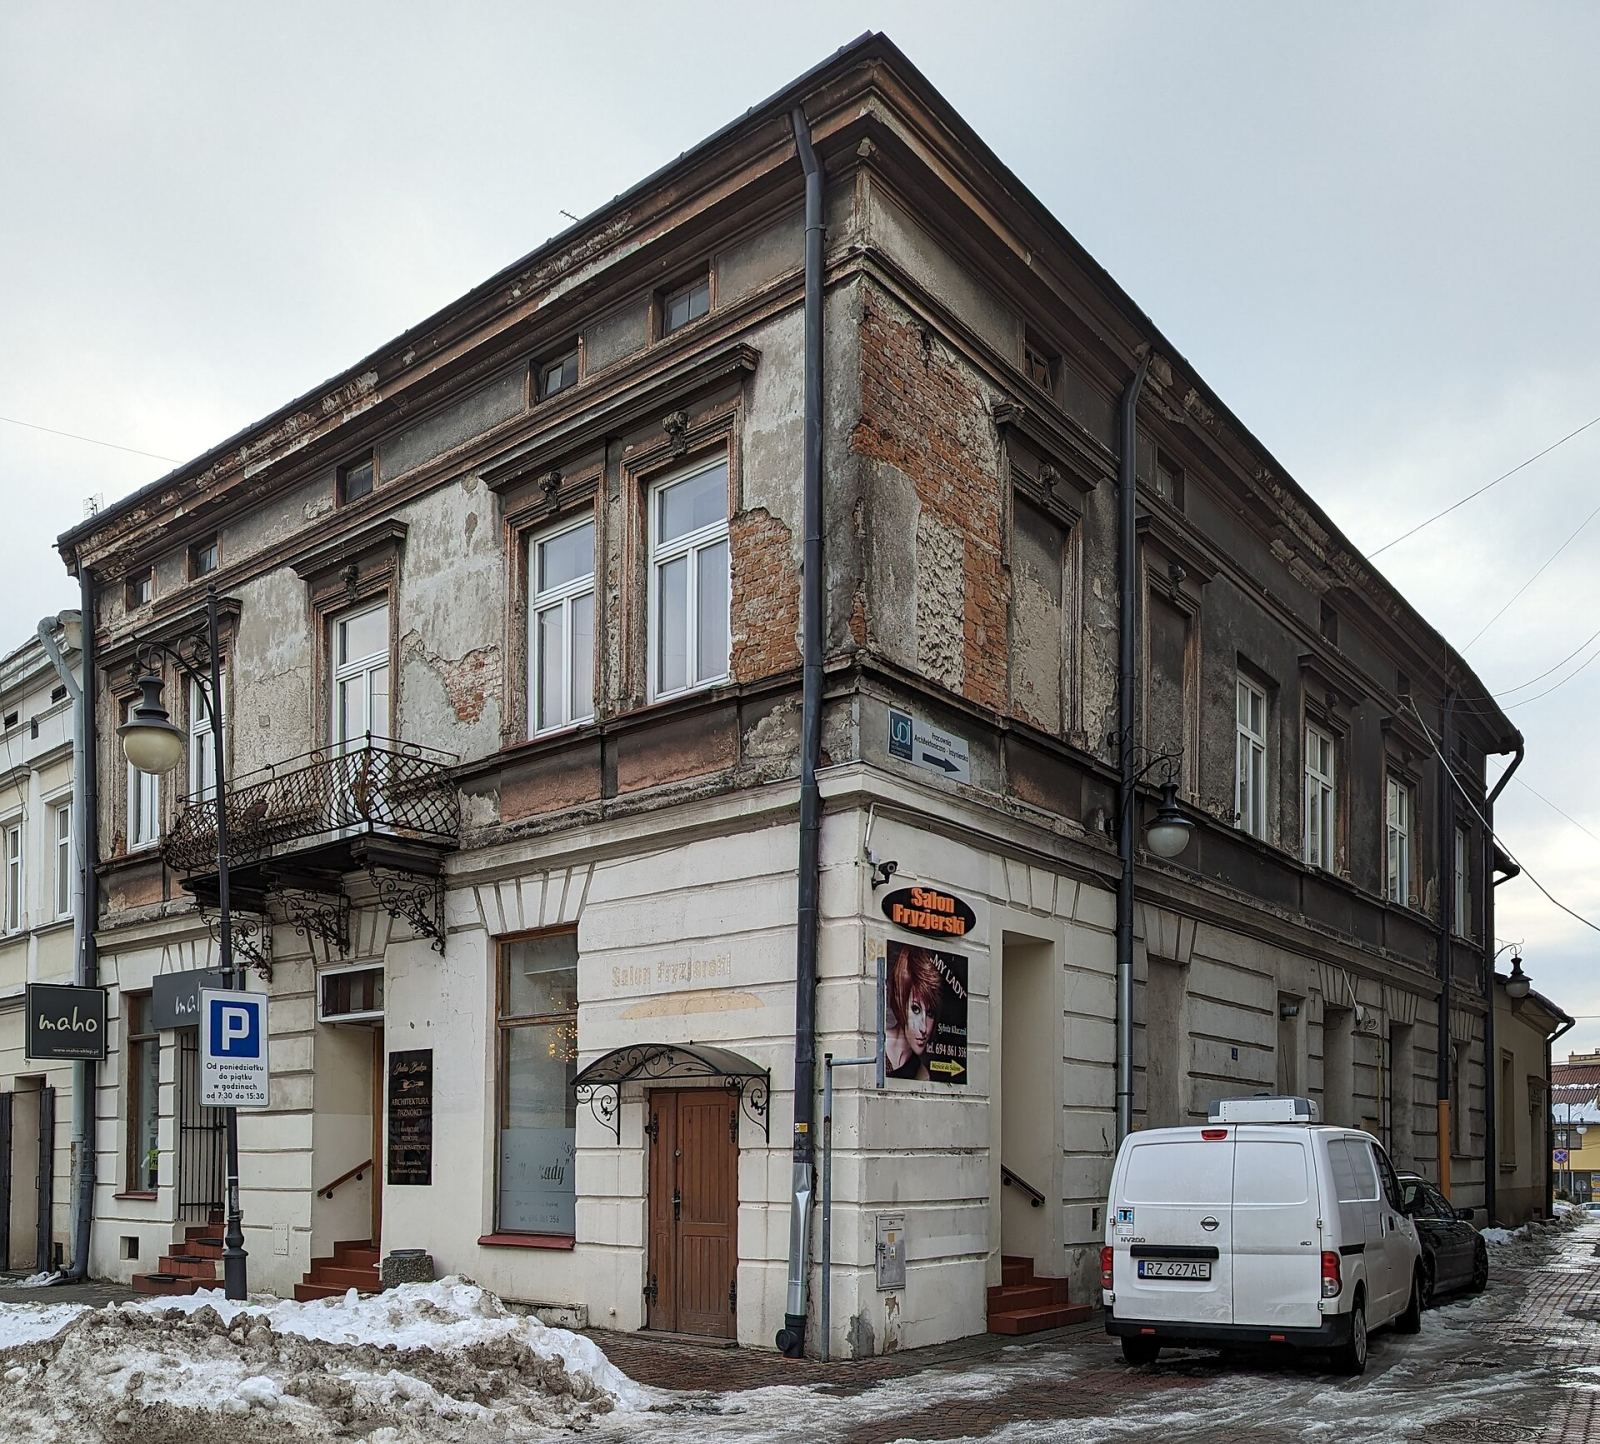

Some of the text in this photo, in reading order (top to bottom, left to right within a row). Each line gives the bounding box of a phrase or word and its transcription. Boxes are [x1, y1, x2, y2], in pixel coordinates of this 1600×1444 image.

[911, 887, 955, 914] Salon
[893, 903, 965, 935] Fryzjerski
[611, 953, 732, 987] Salon Fryzjerski
[39, 1006, 98, 1033] maho
[221, 1006, 250, 1051] P
[206, 1062, 264, 1072] Od poniedziałku
[221, 1083, 258, 1091] godzinach
[1146, 1262, 1163, 1276] RZ
[1167, 1263, 1207, 1277] 627AE
